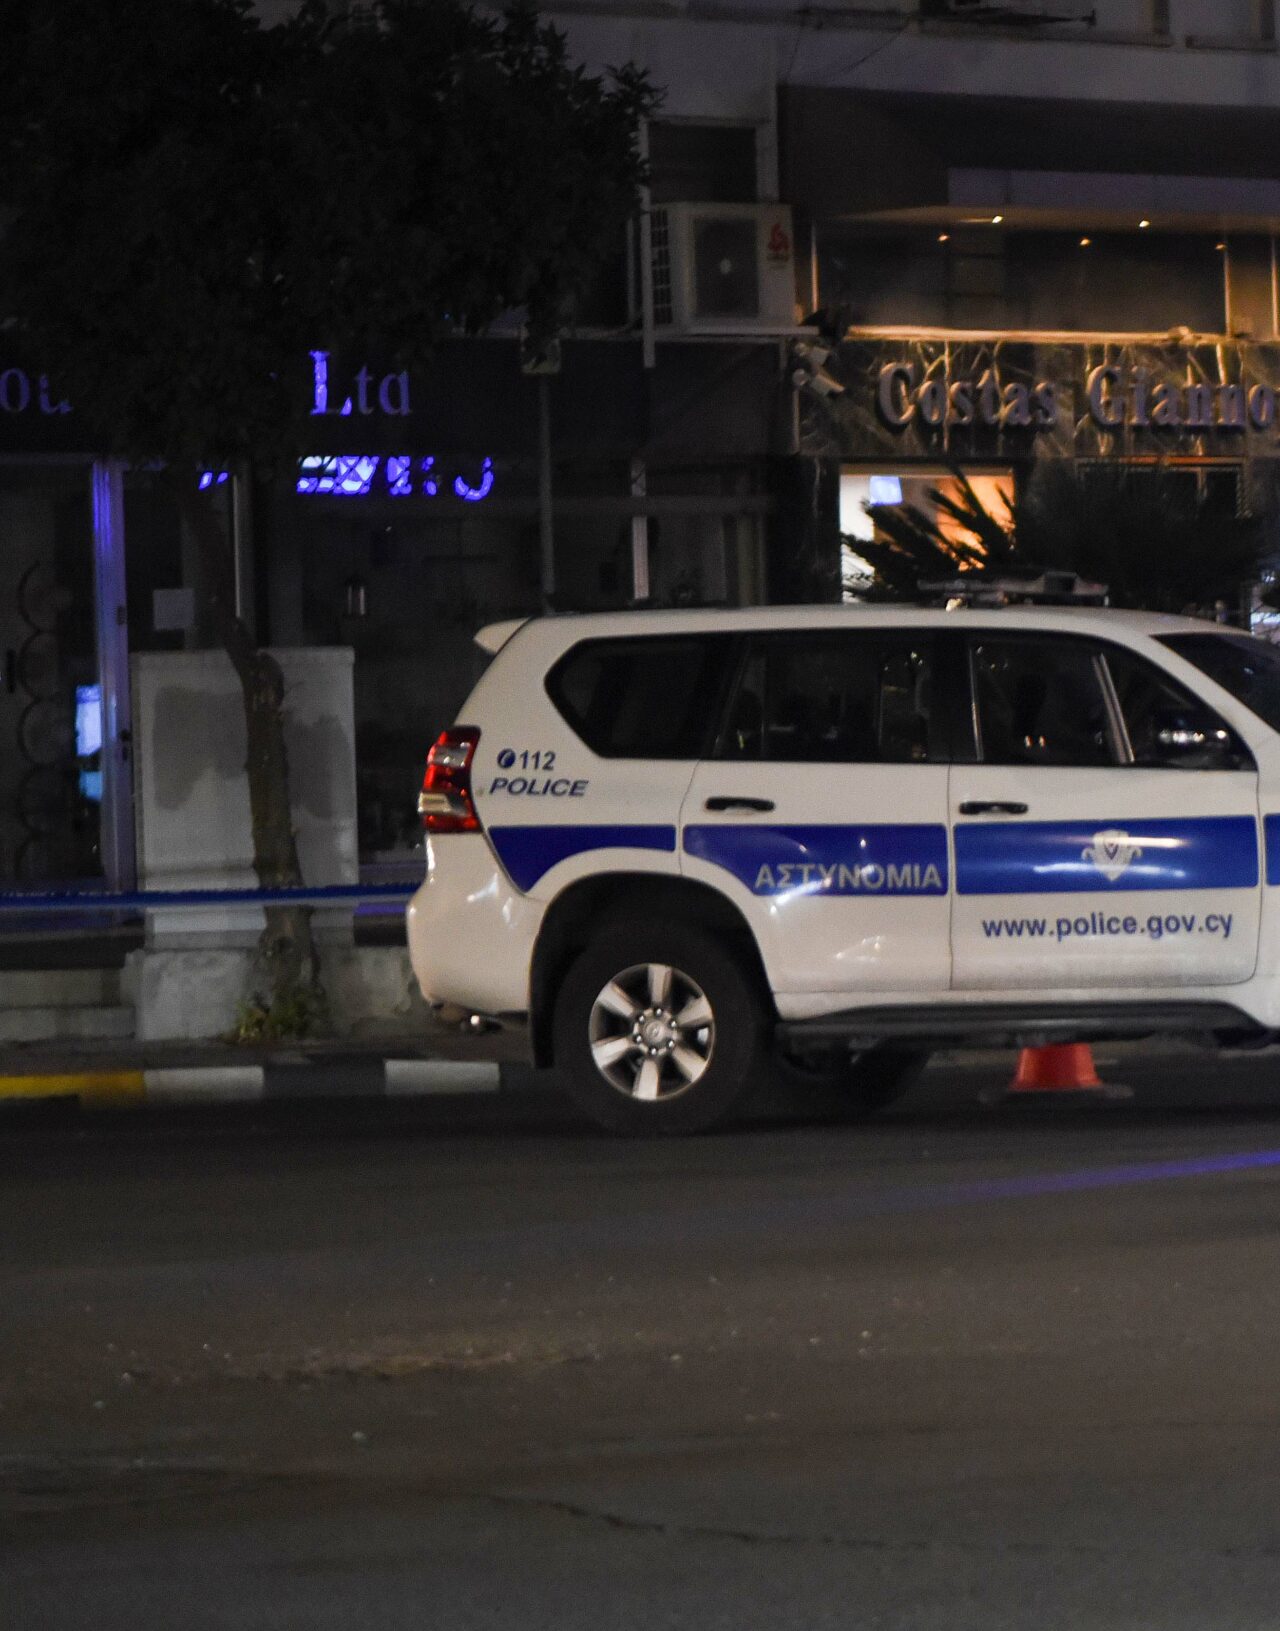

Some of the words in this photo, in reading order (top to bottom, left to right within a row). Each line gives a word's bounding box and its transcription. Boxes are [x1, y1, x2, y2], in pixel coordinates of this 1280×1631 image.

[878, 360, 1058, 426] Costas
[520, 749, 556, 771] 112
[489, 777, 589, 796] POLICE
[754, 863, 943, 889] ΑΣΤΥΝΟΜΙΑ
[982, 911, 1233, 941] www.police.gov.cy
